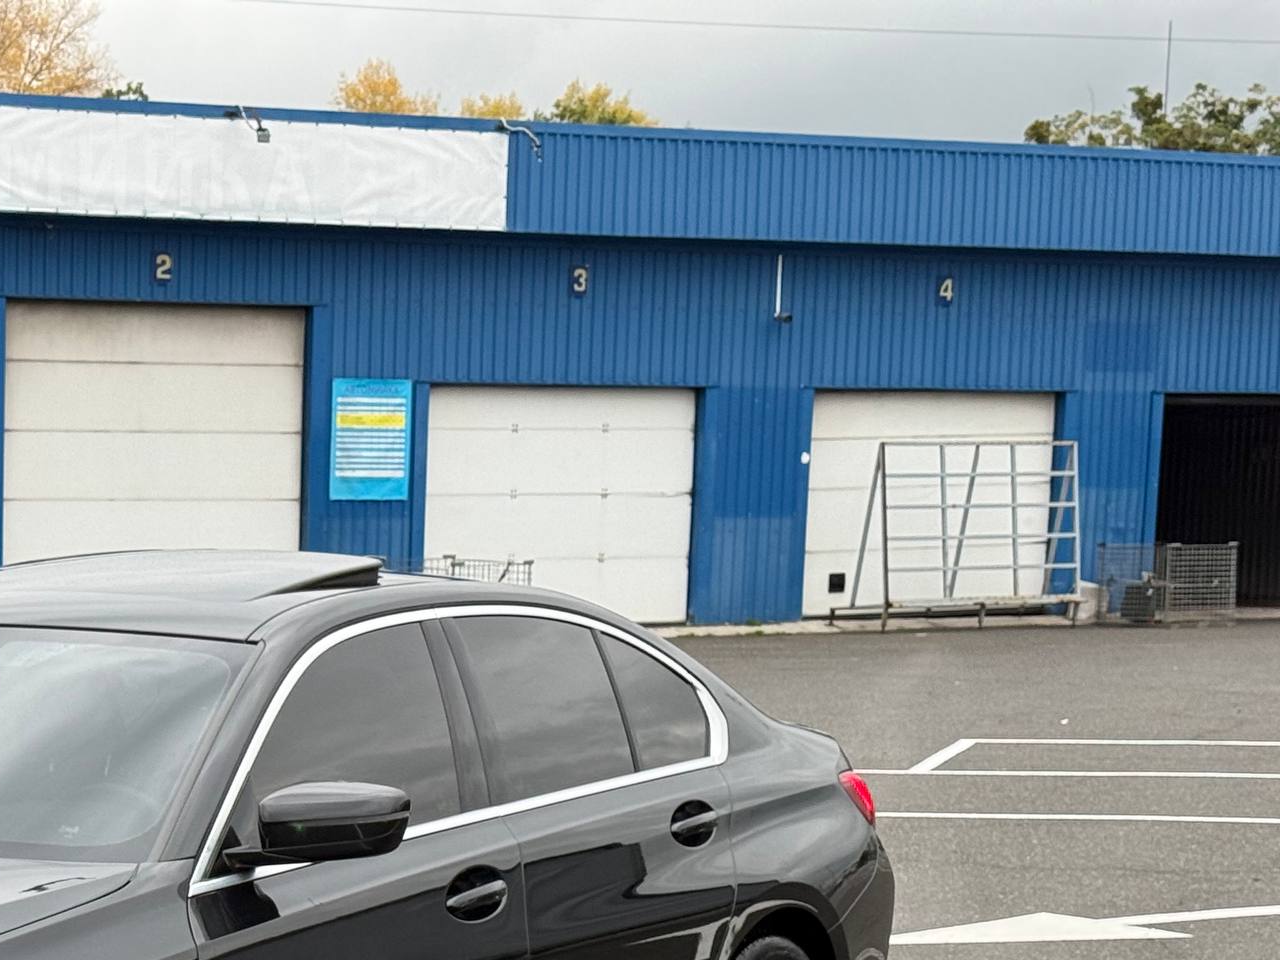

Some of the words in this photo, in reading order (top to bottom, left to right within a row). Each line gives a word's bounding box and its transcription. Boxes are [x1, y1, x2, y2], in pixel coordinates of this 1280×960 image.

[156, 254, 172, 279] 2
[573, 268, 588, 292] 3
[939, 278, 953, 302] 4
